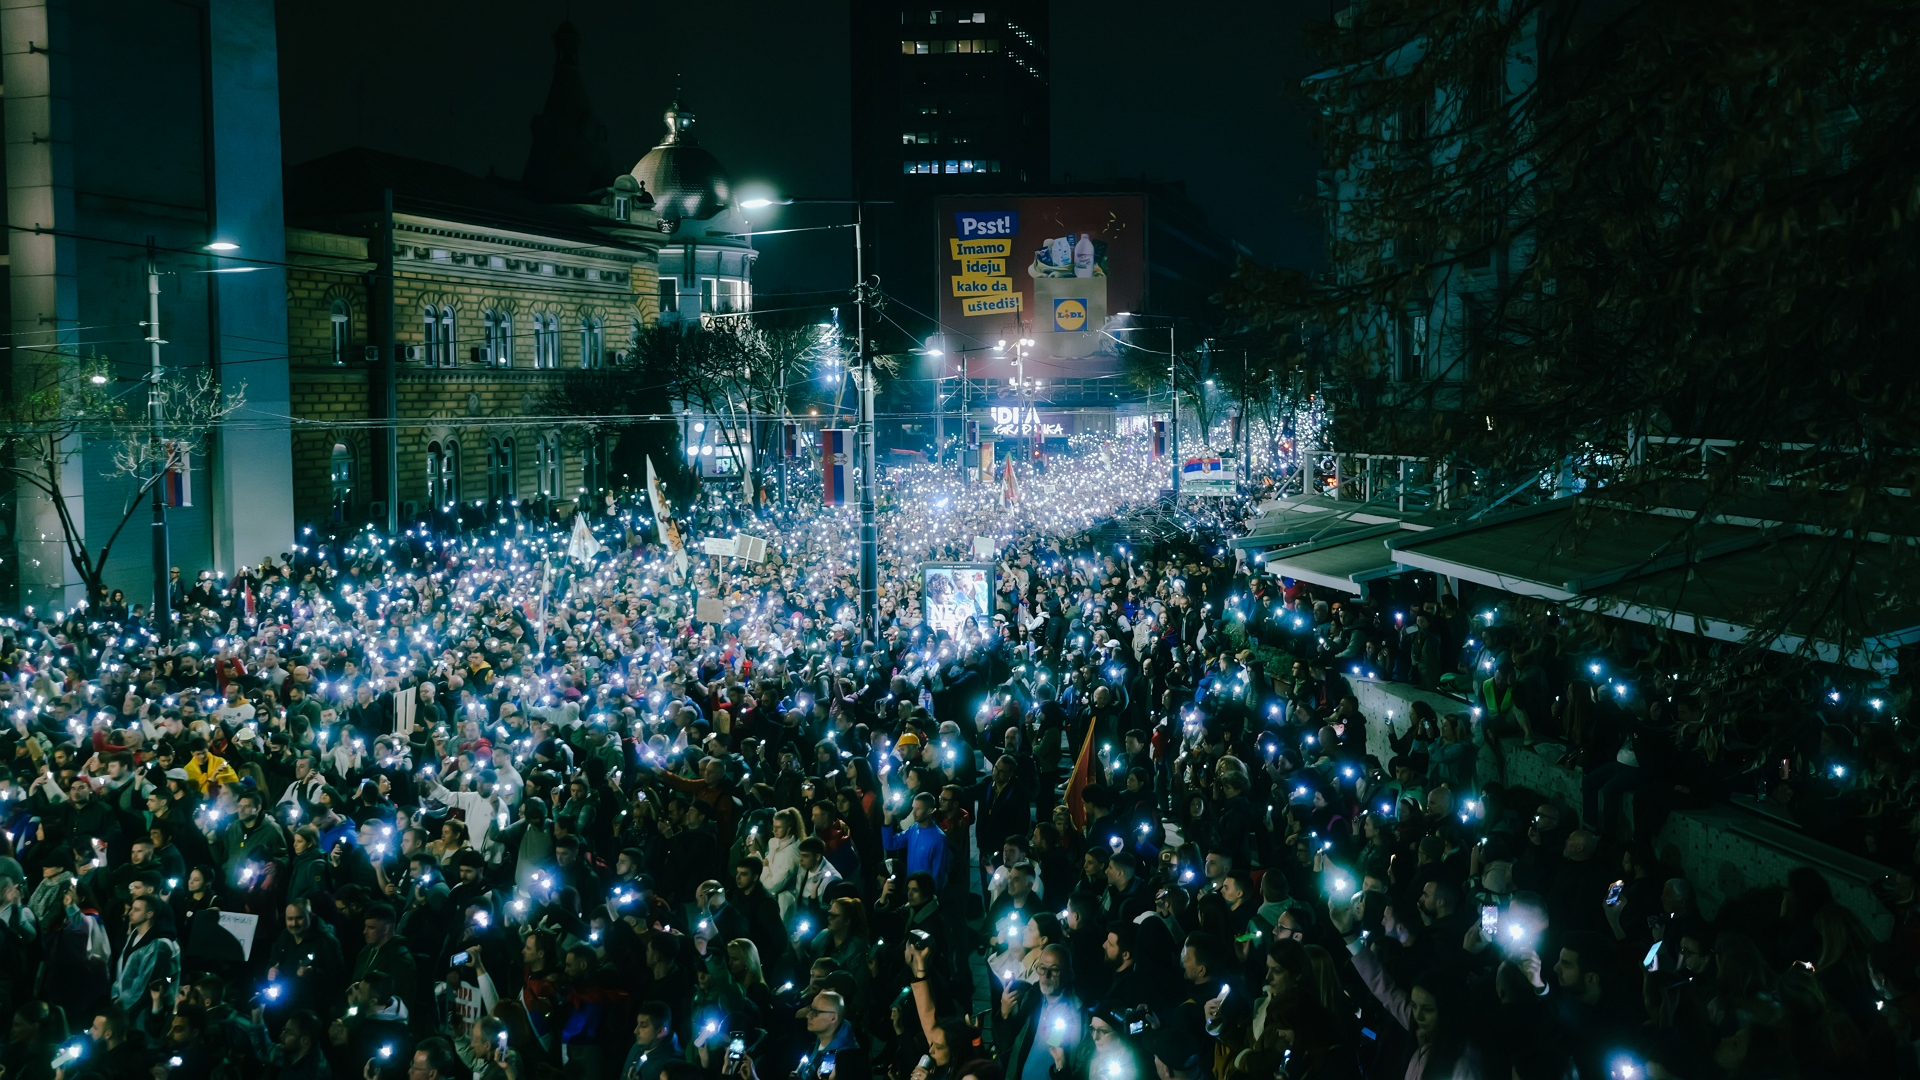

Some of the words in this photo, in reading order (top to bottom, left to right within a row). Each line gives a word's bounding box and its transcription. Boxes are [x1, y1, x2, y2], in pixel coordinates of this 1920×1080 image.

[962, 216, 1011, 235] Psst!
[957, 243, 1005, 255] Imamo
[966, 260, 1001, 275] ideju
[957, 281, 988, 291] kako
[991, 281, 1007, 291] da
[968, 297, 1019, 312] uštediš!
